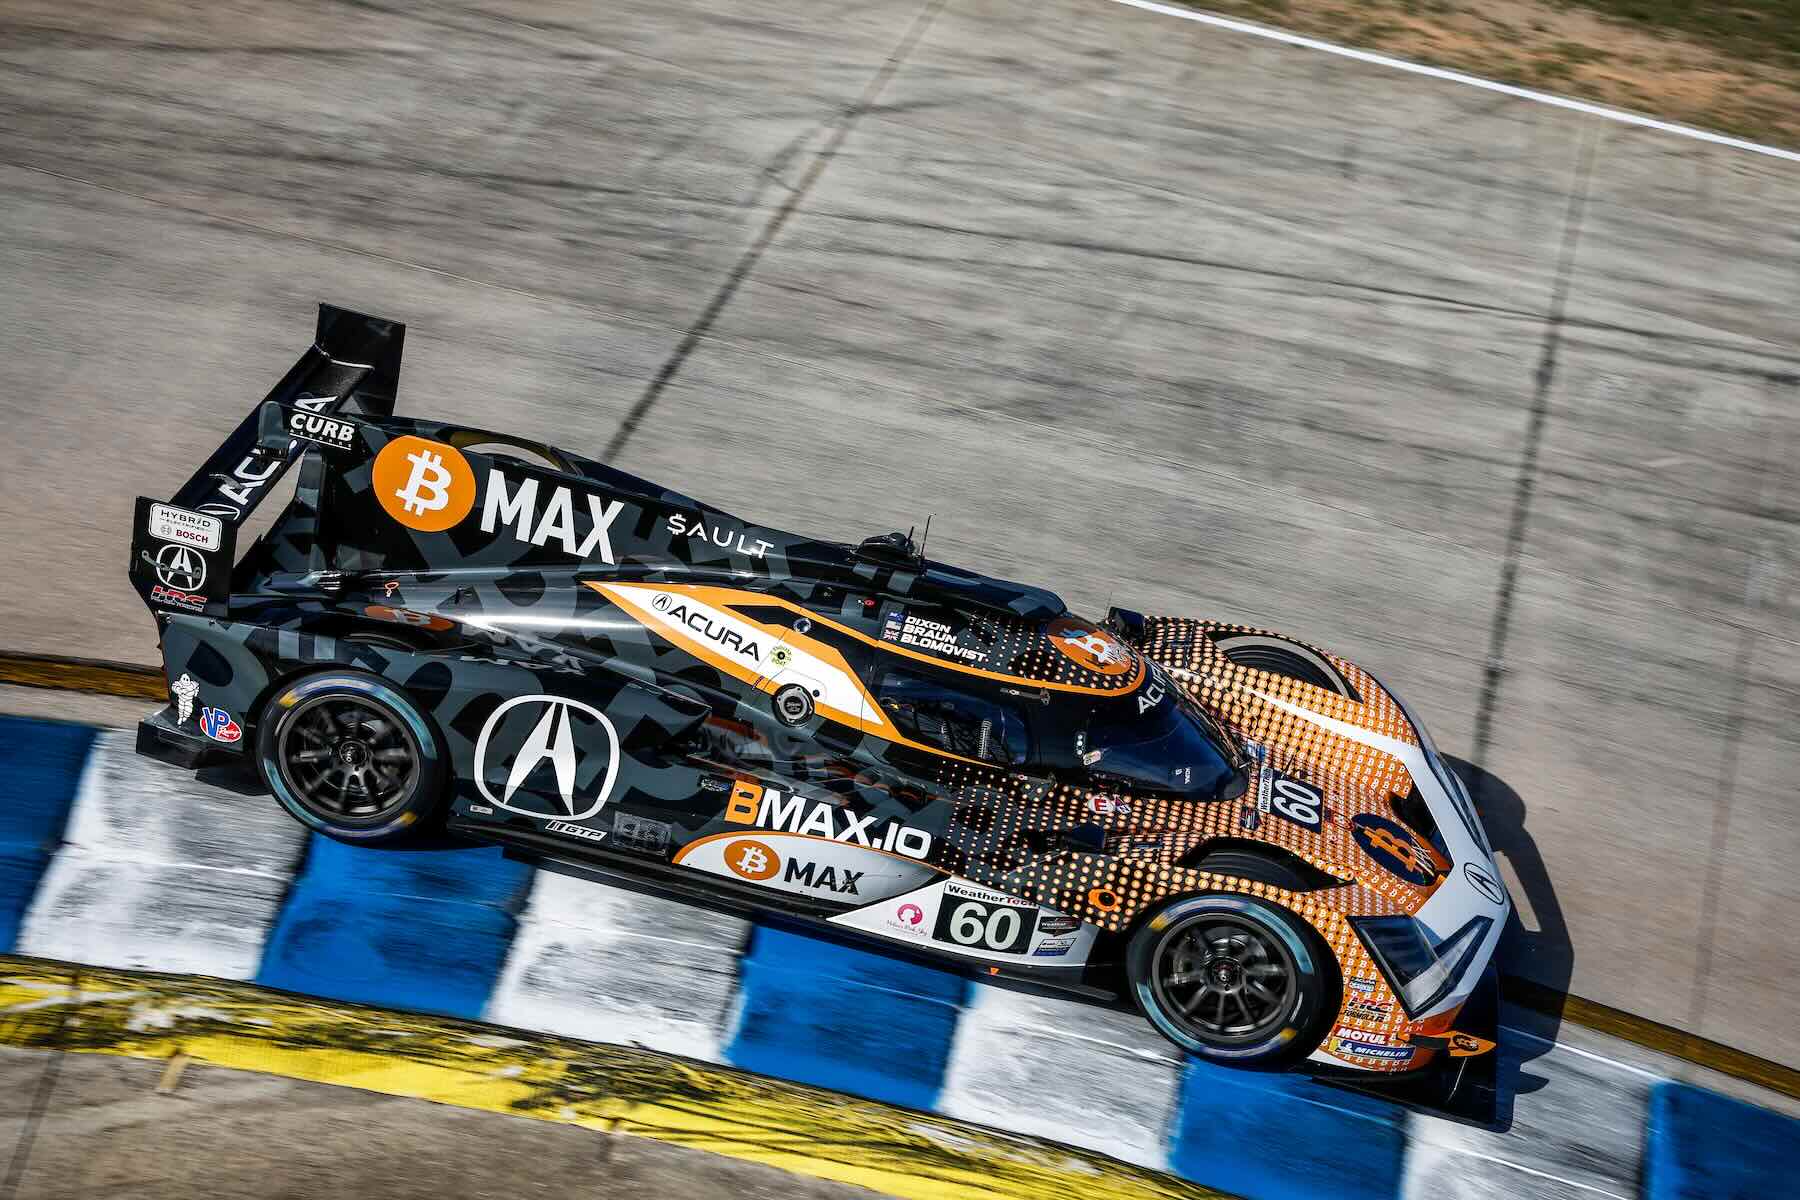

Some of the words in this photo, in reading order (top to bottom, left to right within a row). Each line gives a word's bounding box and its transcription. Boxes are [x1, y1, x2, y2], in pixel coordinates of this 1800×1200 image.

[289, 413, 355, 442] CURB
[160, 509, 212, 528] HYBRID
[480, 468, 626, 566] MAX
[175, 529, 209, 544] BOSCH
[667, 604, 761, 662] ACURA
[902, 623, 958, 645] BRAUN
[904, 615, 952, 634] DIXON
[900, 633, 988, 662] BLOMQVIST
[203, 707, 230, 738] VP
[1260, 767, 1273, 811] WeatherTech
[1273, 779, 1321, 824] 60
[564, 825, 602, 838] GTP
[724, 779, 933, 860] BMAX.IO
[783, 857, 865, 896] MAX
[948, 885, 1039, 908] WeatherTech
[949, 901, 1022, 951] 60
[1336, 1027, 1387, 1045] MOTUL
[1354, 1046, 1409, 1058] MICHELIN
